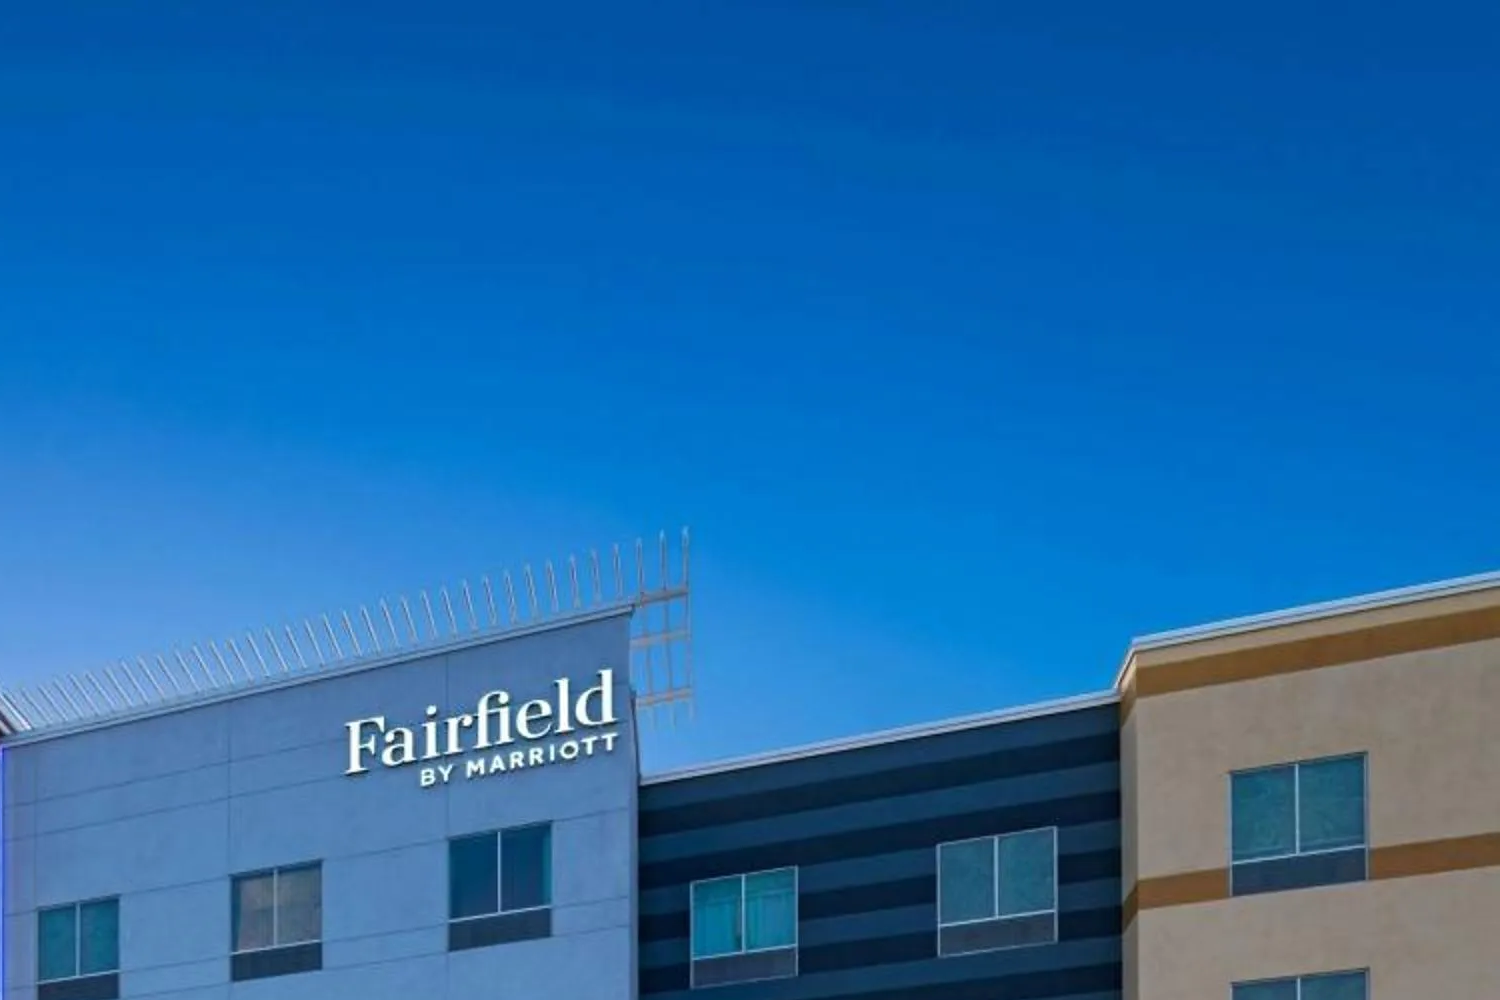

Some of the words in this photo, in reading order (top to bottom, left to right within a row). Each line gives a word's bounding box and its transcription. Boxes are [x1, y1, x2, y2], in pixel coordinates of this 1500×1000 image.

[344, 668, 618, 775] Fairfield
[420, 765, 453, 787] BY
[466, 733, 618, 778] MARRIOTT
